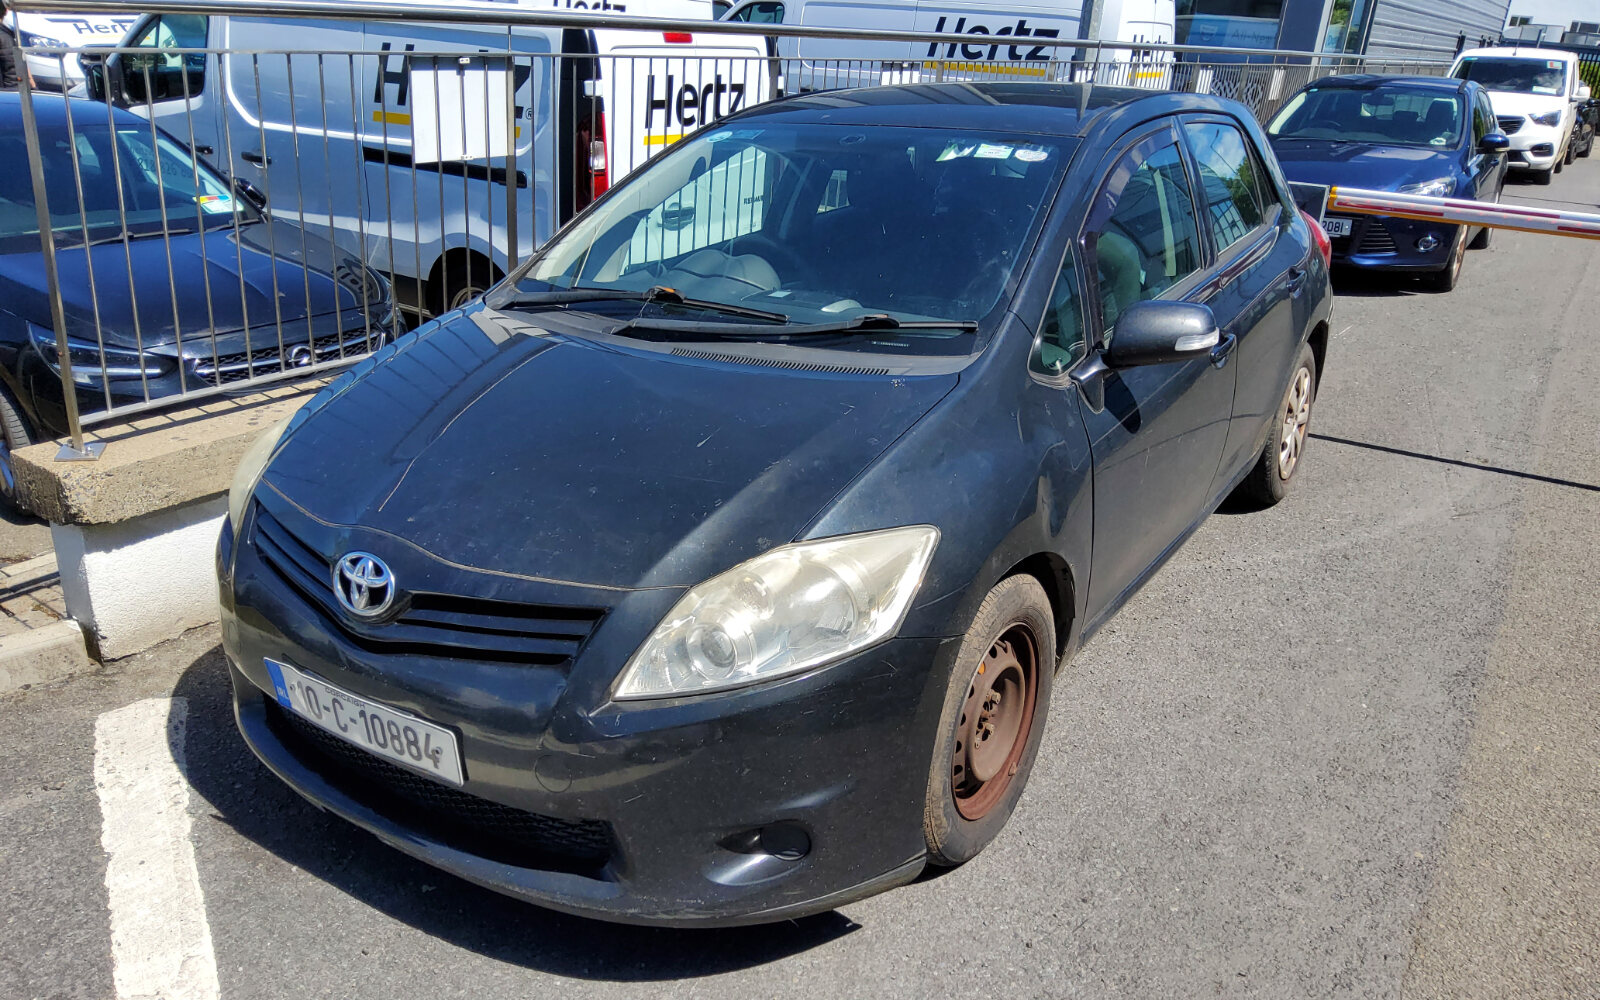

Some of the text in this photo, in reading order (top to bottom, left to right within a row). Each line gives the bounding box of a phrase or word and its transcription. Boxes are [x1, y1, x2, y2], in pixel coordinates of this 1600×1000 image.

[73, 22, 128, 34] Hert
[927, 16, 1060, 61] Hertz
[645, 74, 745, 127] Hertz
[297, 680, 442, 769] 10-C-10884
